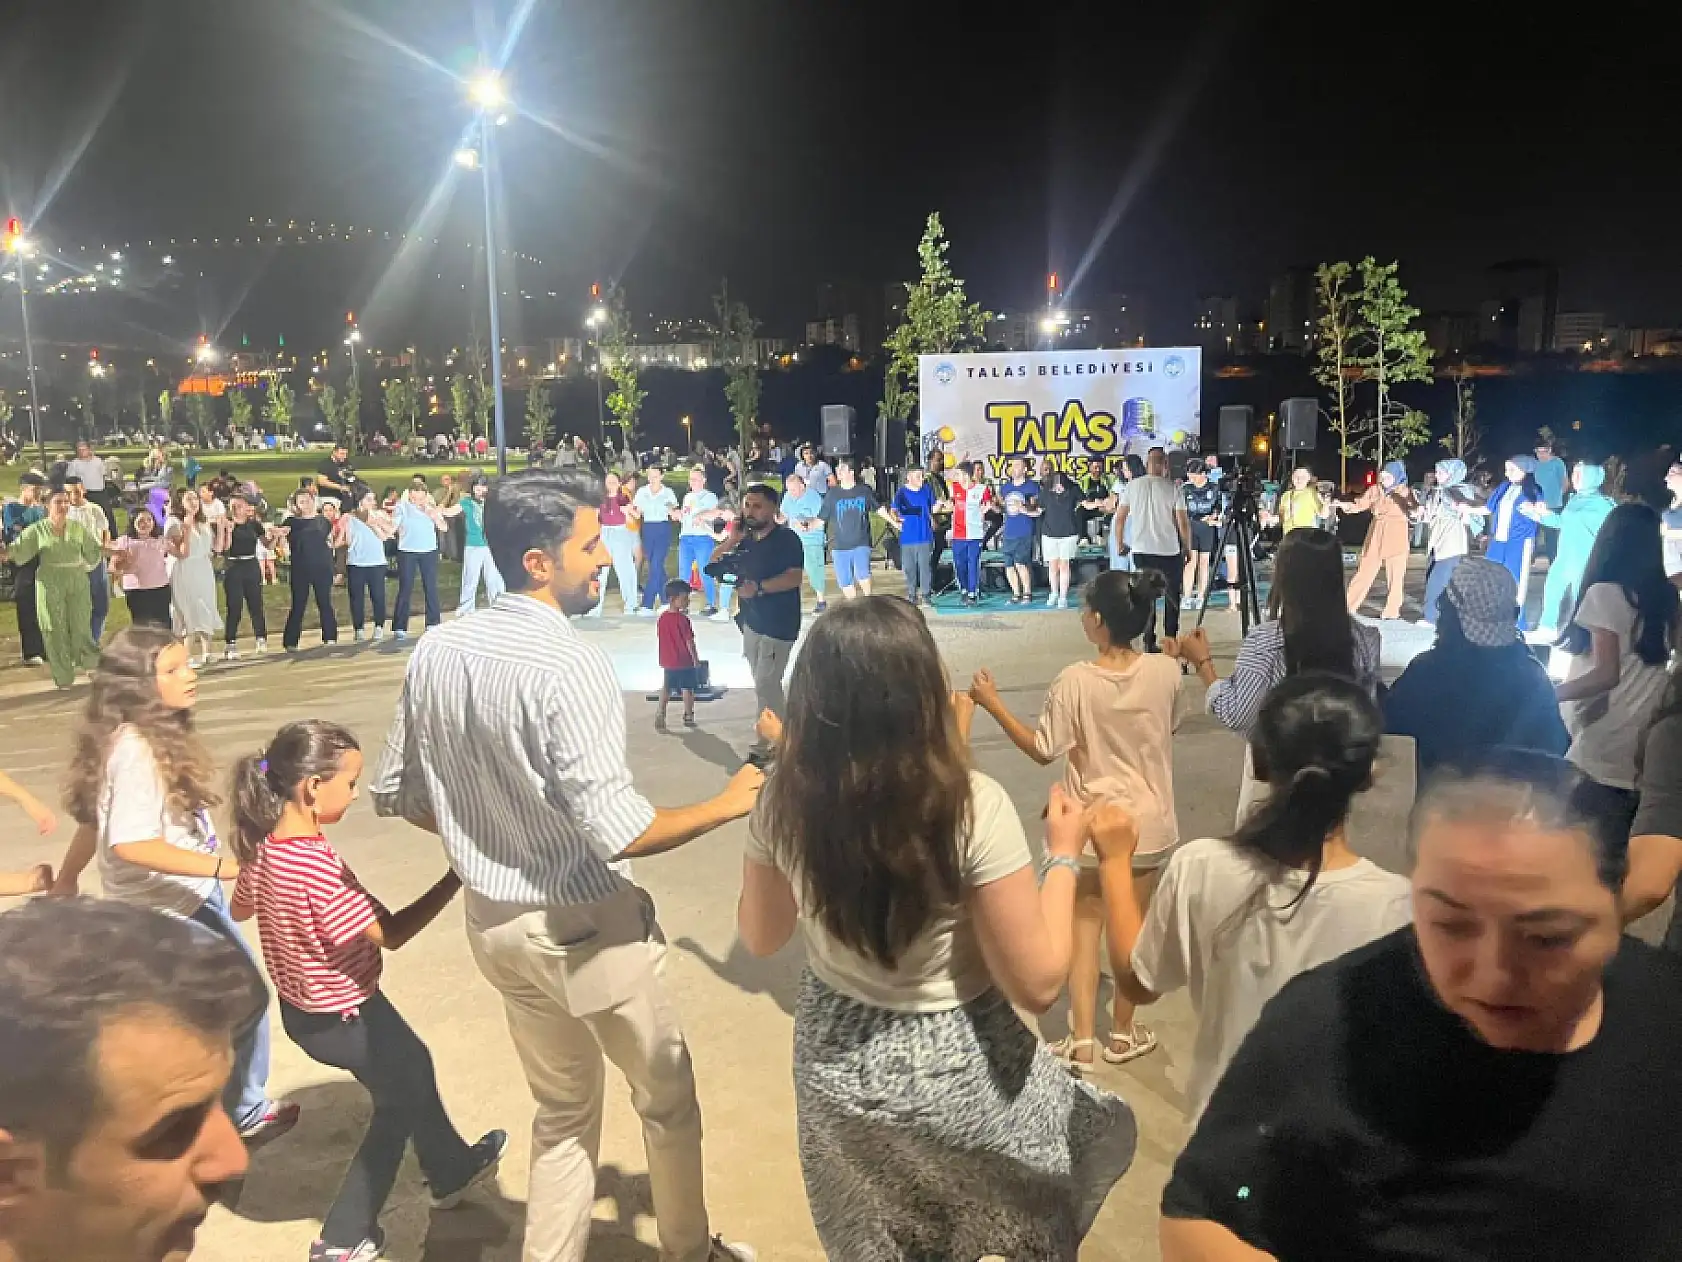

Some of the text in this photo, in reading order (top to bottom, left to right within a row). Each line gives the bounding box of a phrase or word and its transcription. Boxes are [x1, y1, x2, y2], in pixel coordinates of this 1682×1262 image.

[966, 361, 1153, 378] TALAS BELEDİYESİ
[985, 399, 1117, 454] TALAS
